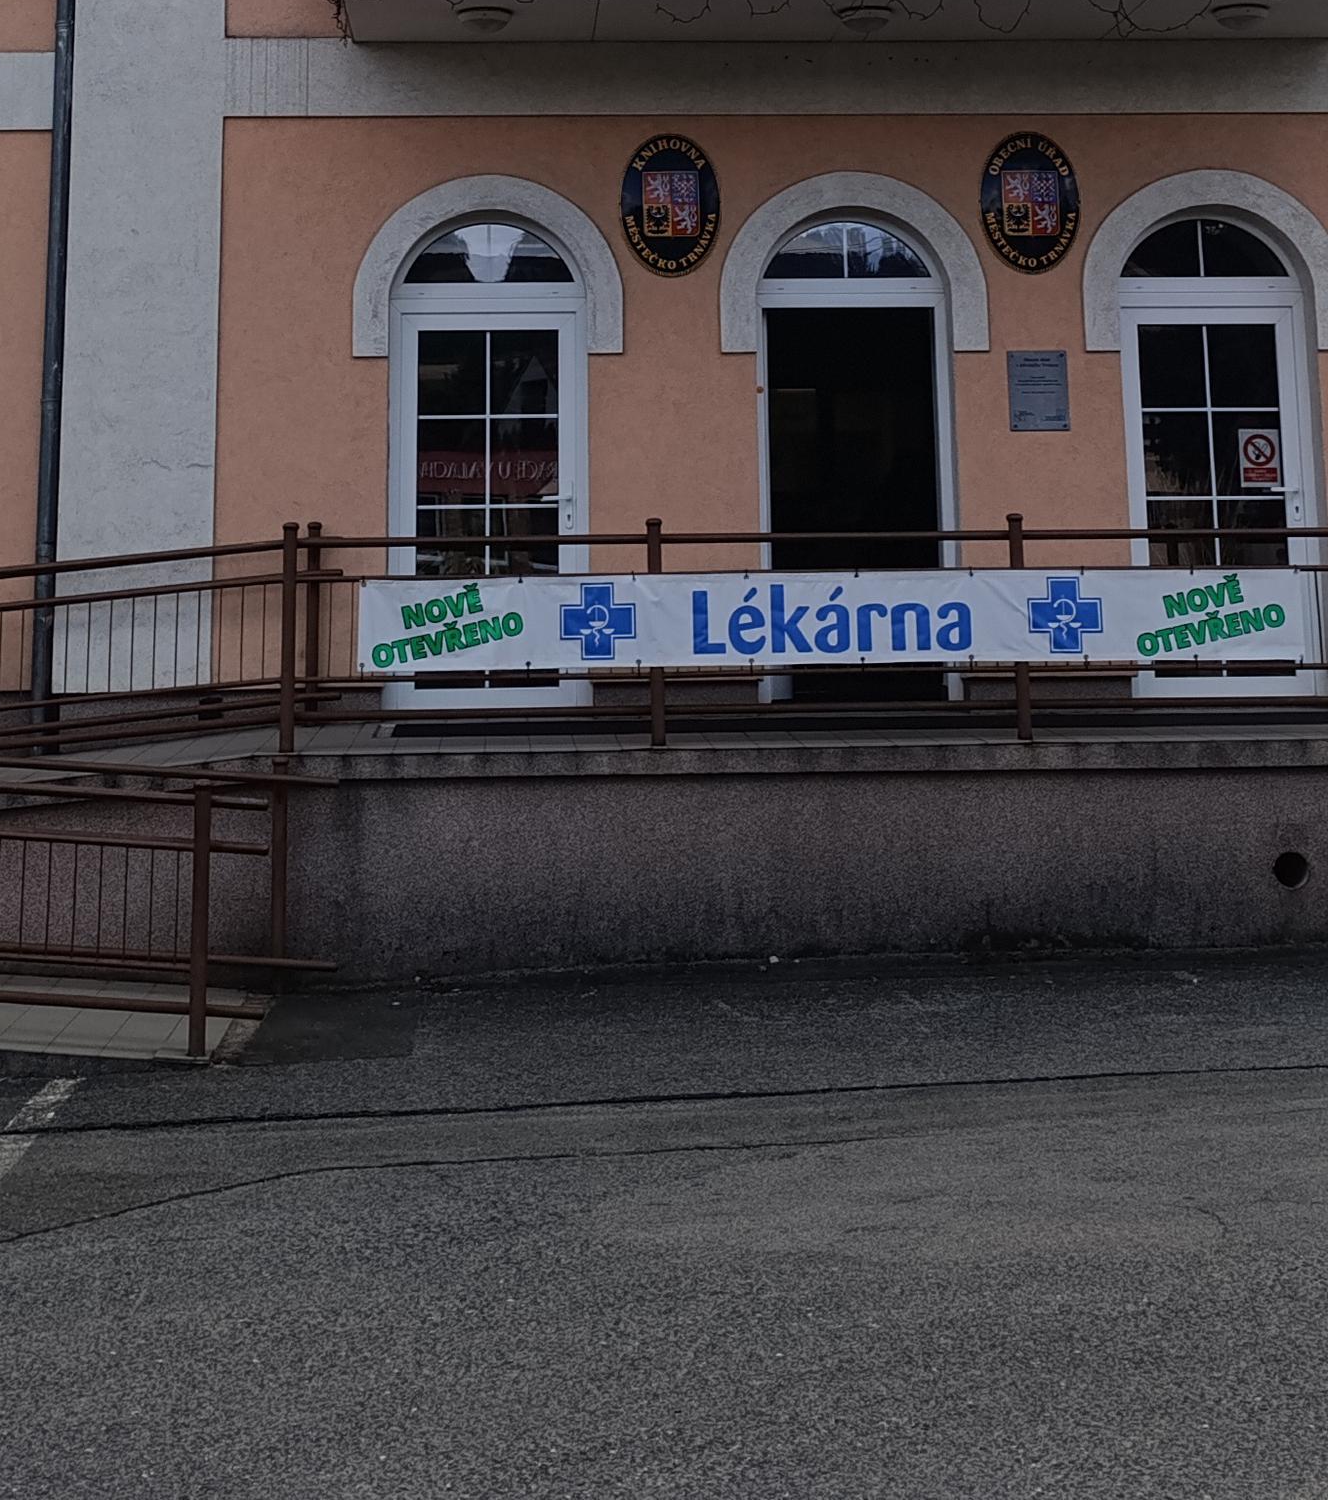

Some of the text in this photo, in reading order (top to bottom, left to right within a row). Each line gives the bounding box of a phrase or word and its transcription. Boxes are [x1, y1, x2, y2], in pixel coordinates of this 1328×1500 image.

[631, 137, 708, 172] KNIHOVNA
[988, 136, 1033, 176] OBECNÍ
[623, 214, 677, 270] MĚSTEČKO
[983, 211, 1037, 268] MĚSTEČKO
[401, 582, 485, 631] NOVĚ
[691, 583, 972, 656] Lékárna
[1162, 573, 1244, 620] NOVĚ
[371, 611, 525, 669] OTEVŘENO
[1136, 603, 1287, 658] OTEVŘENO
